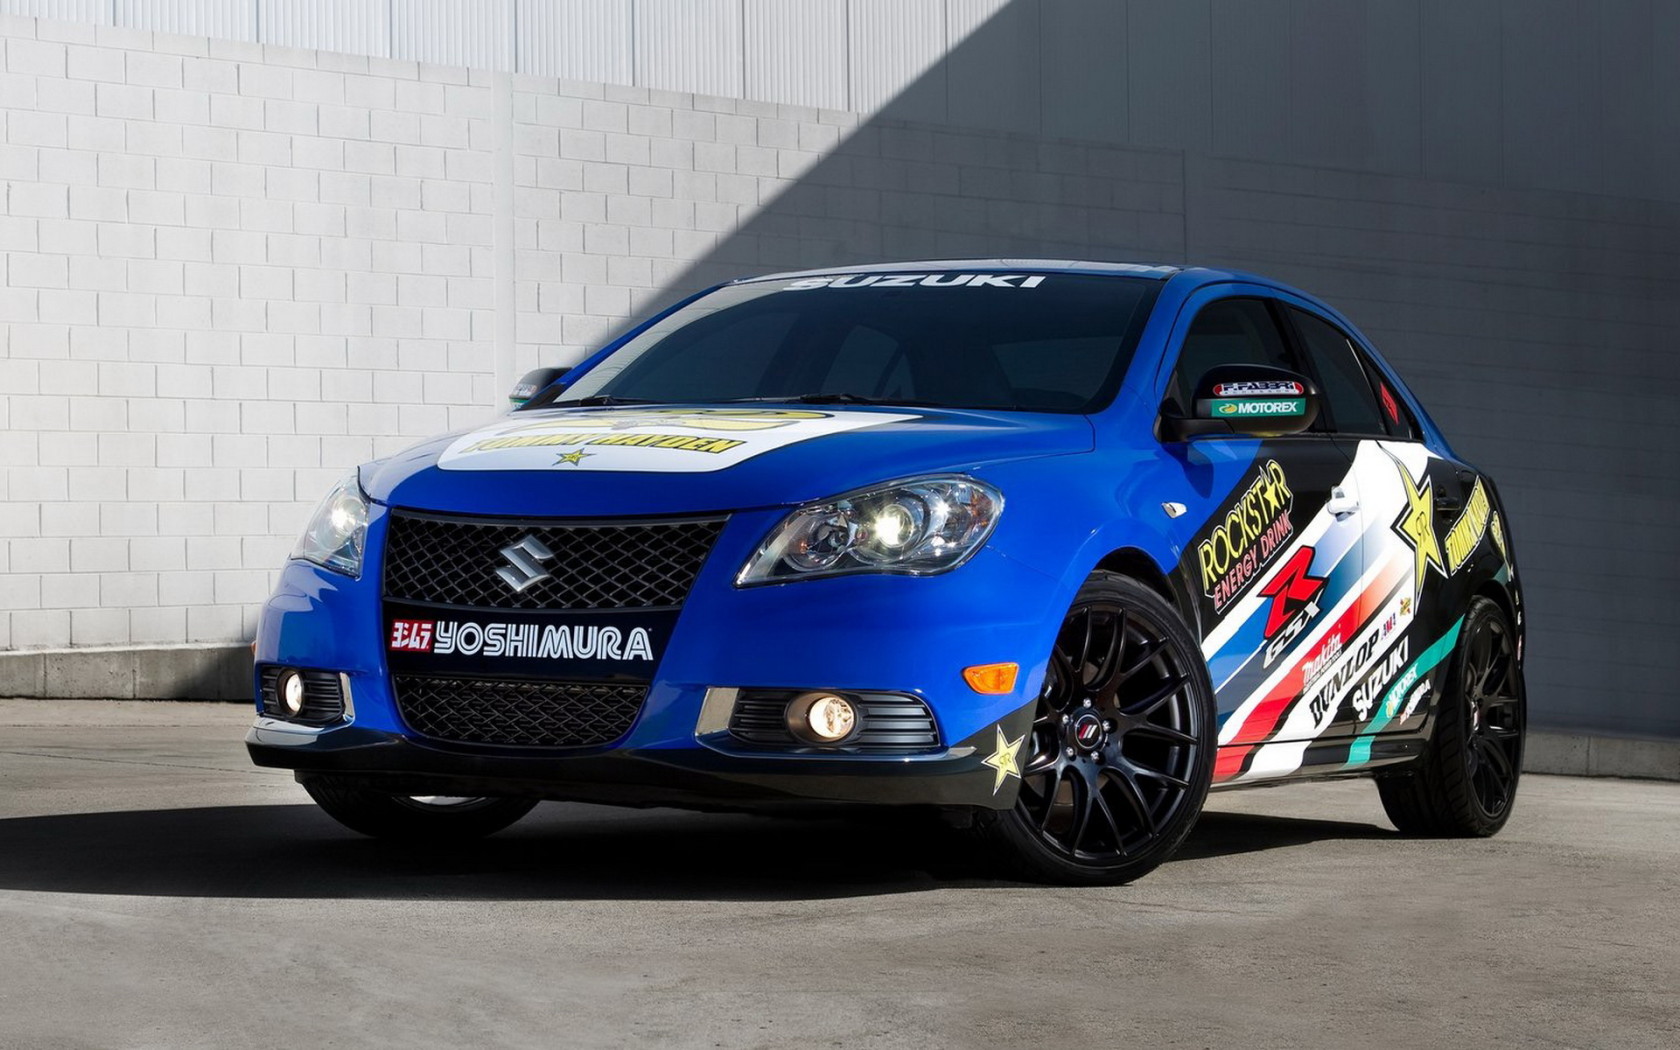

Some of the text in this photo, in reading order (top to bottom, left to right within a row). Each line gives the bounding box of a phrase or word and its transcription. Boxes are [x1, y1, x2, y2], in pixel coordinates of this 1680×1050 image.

[783, 274, 1046, 291] SUZUKI
[1238, 402, 1298, 414] MOTOREX
[586, 433, 748, 454] HAYDEN
[1213, 509, 1292, 608] ENERGY DRINK
[433, 620, 654, 661] YOSHIMURA
[1309, 628, 1380, 730] DUNLOP
[1352, 635, 1409, 722] SUZUKI
